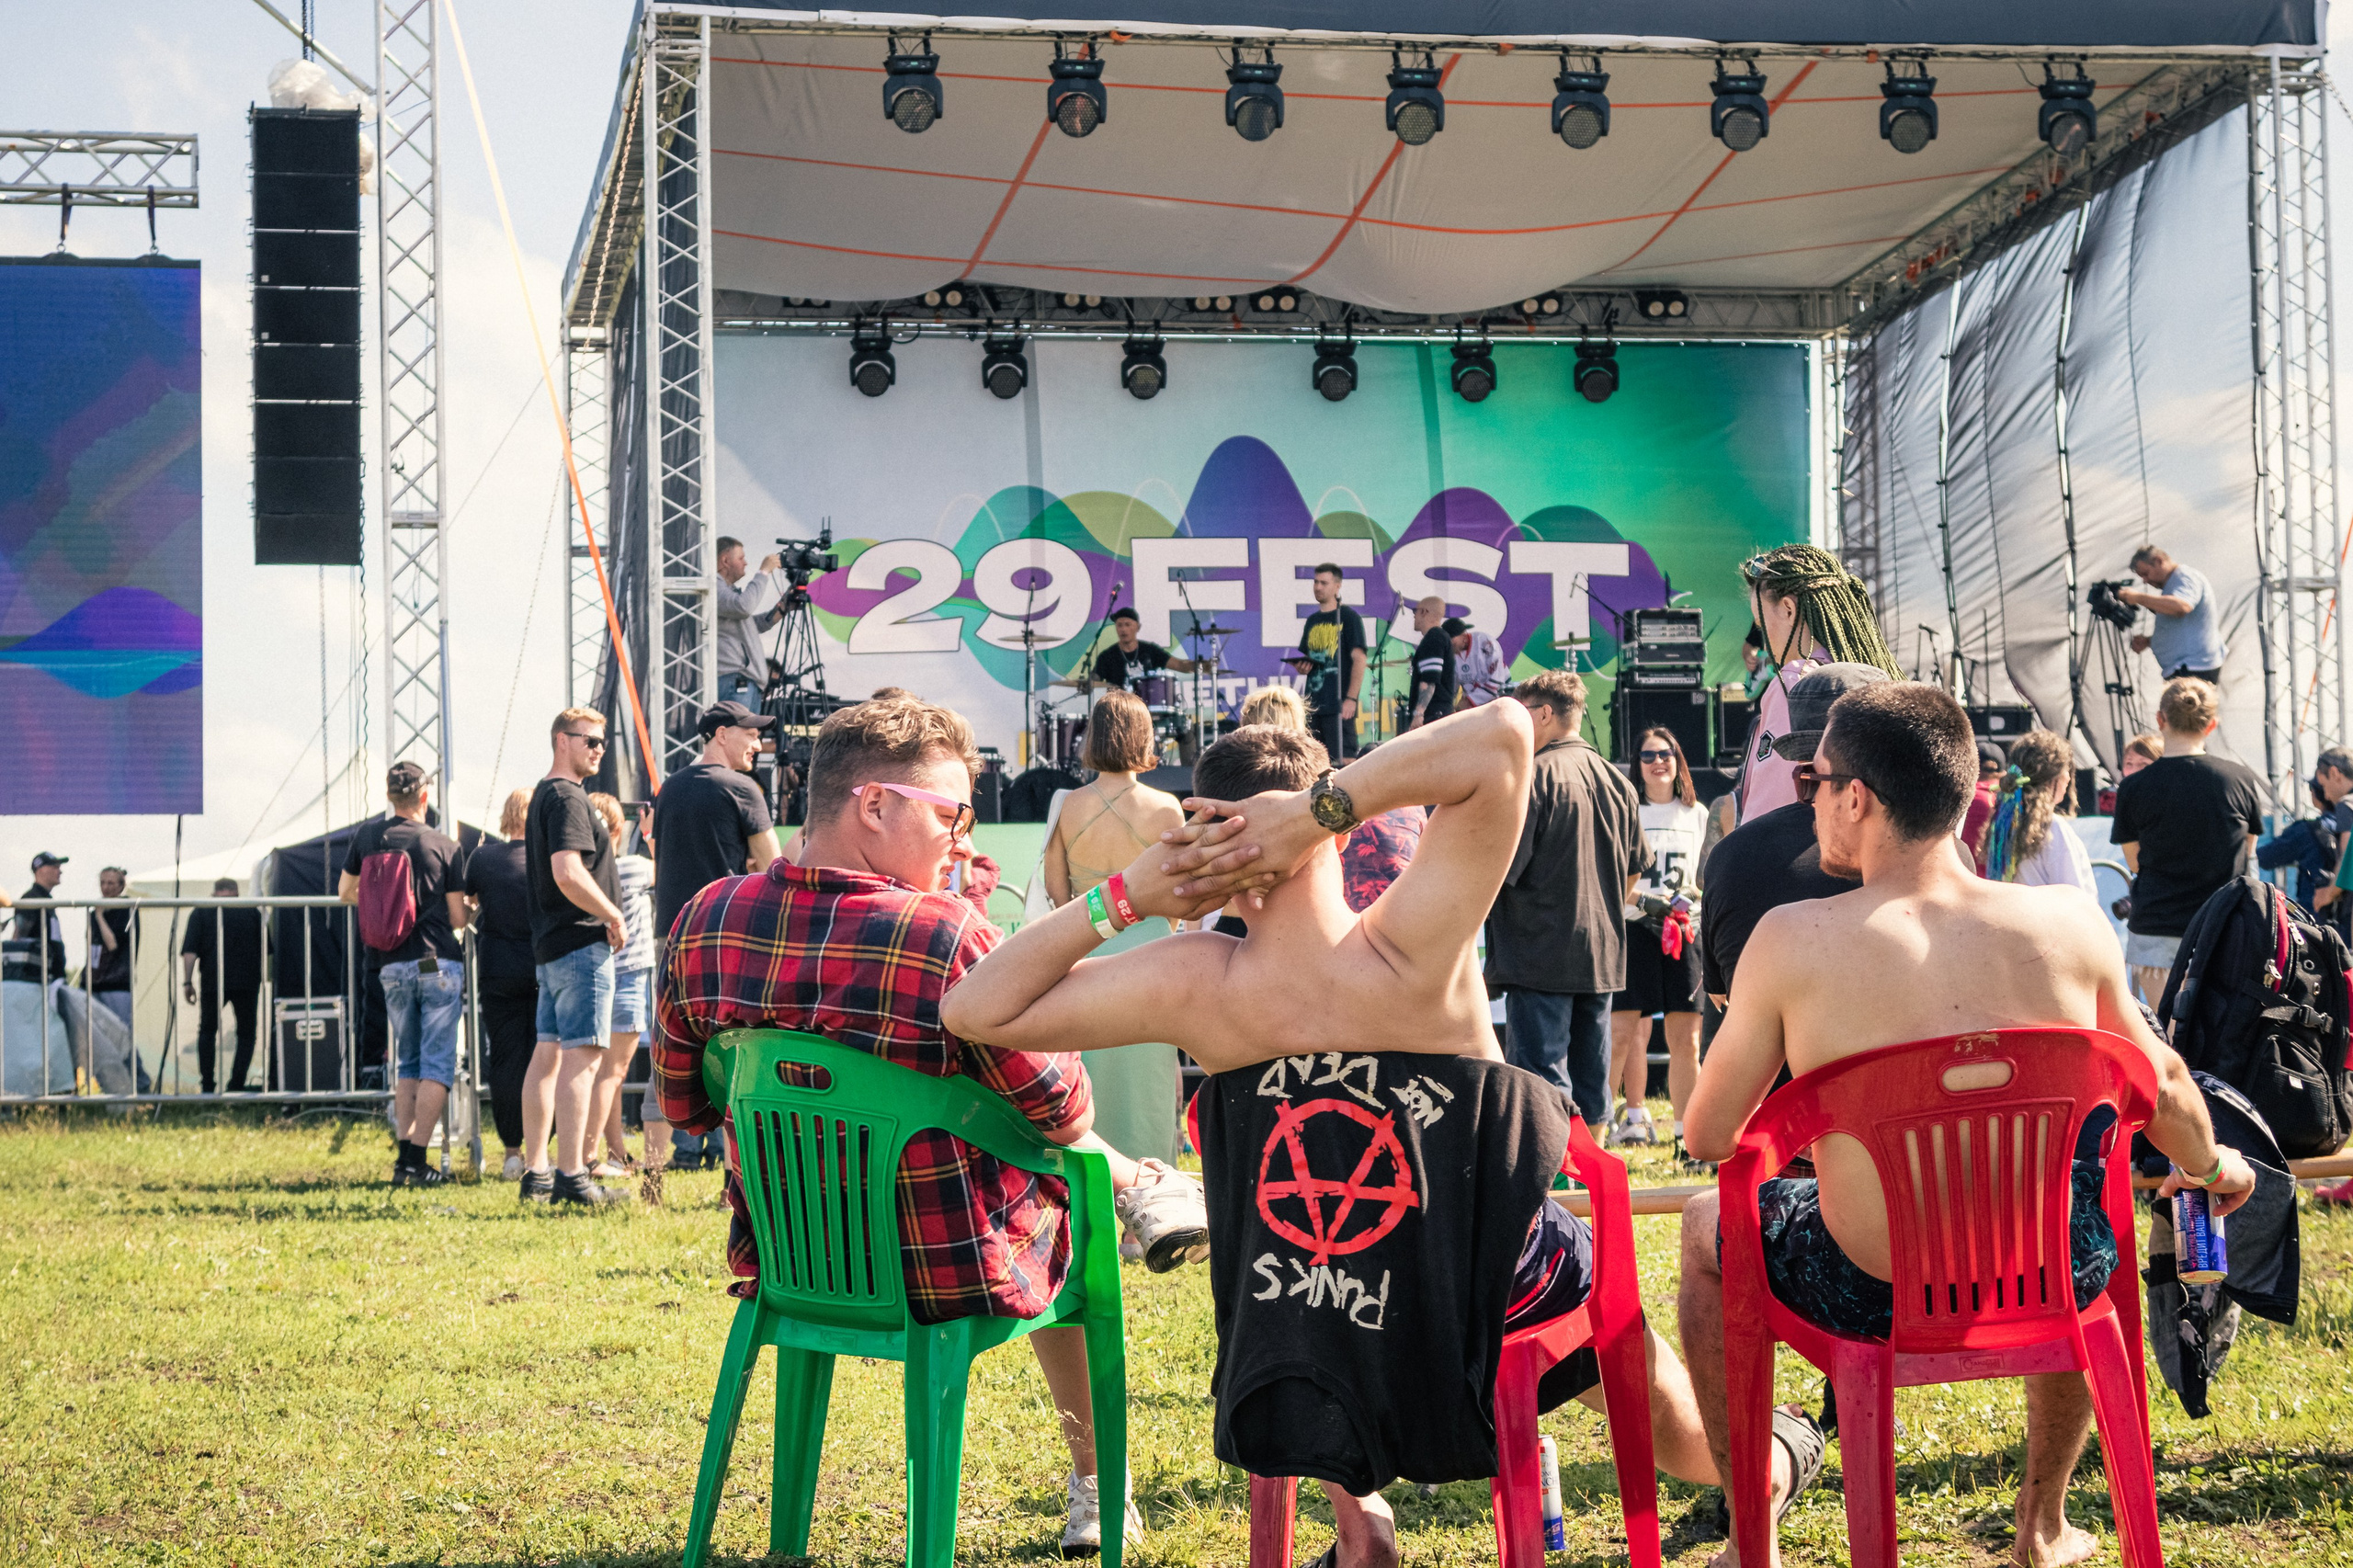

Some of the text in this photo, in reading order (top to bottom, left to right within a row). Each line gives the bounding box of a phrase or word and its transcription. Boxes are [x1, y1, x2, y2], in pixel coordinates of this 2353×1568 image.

[847, 536, 1631, 655] 29 FEST
[1640, 850, 1684, 890] 45
[1117, 899, 1131, 916] 29
[1256, 1051, 1386, 1110] DEAD
[2197, 1238, 2208, 1268] ВРЕДИТ
[1253, 1253, 1391, 1330] PUNKS
